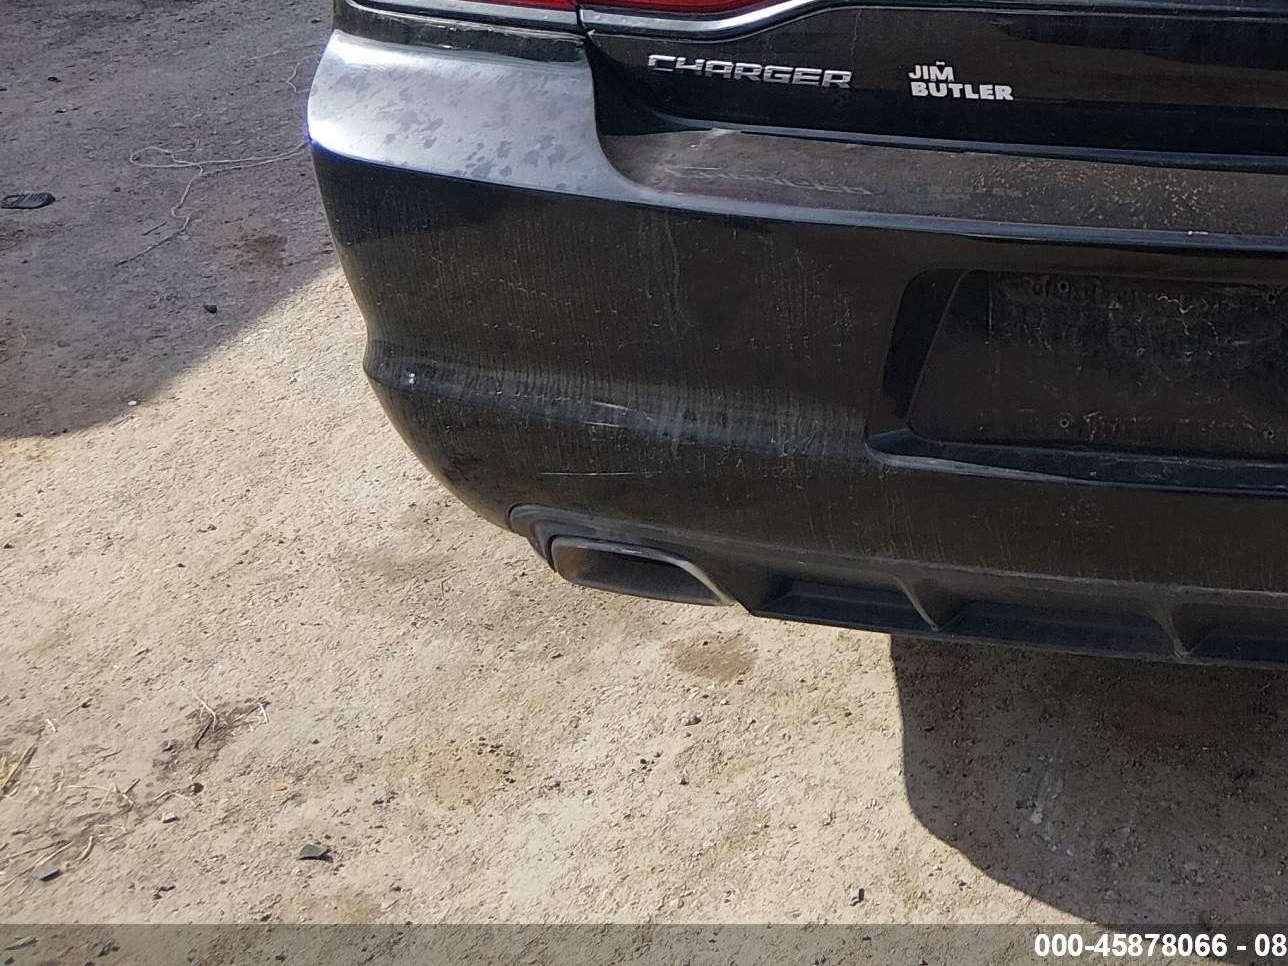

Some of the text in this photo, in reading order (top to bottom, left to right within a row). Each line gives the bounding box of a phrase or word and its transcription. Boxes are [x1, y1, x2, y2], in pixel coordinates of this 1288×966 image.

[648, 54, 853, 89] CHARGER
[908, 64, 955, 82] JIM
[911, 82, 1014, 101] BUTLER
